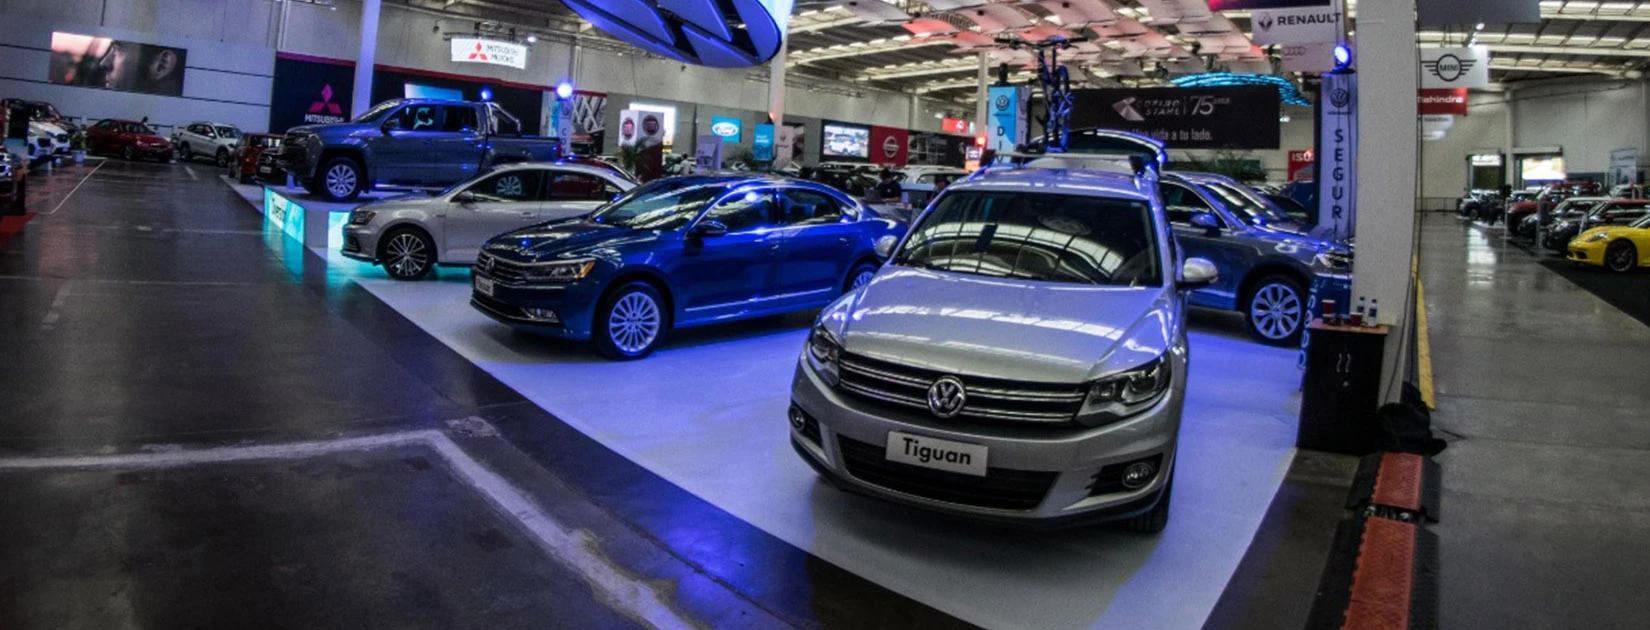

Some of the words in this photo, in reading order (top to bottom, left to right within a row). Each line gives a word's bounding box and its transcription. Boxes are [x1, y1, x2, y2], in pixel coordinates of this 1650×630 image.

[1277, 13, 1342, 26] RENAULT
[1440, 64, 1459, 72] MINI
[1190, 95, 1214, 115] 75
[1171, 130, 1177, 140] a
[903, 437, 971, 465] Tiguan
